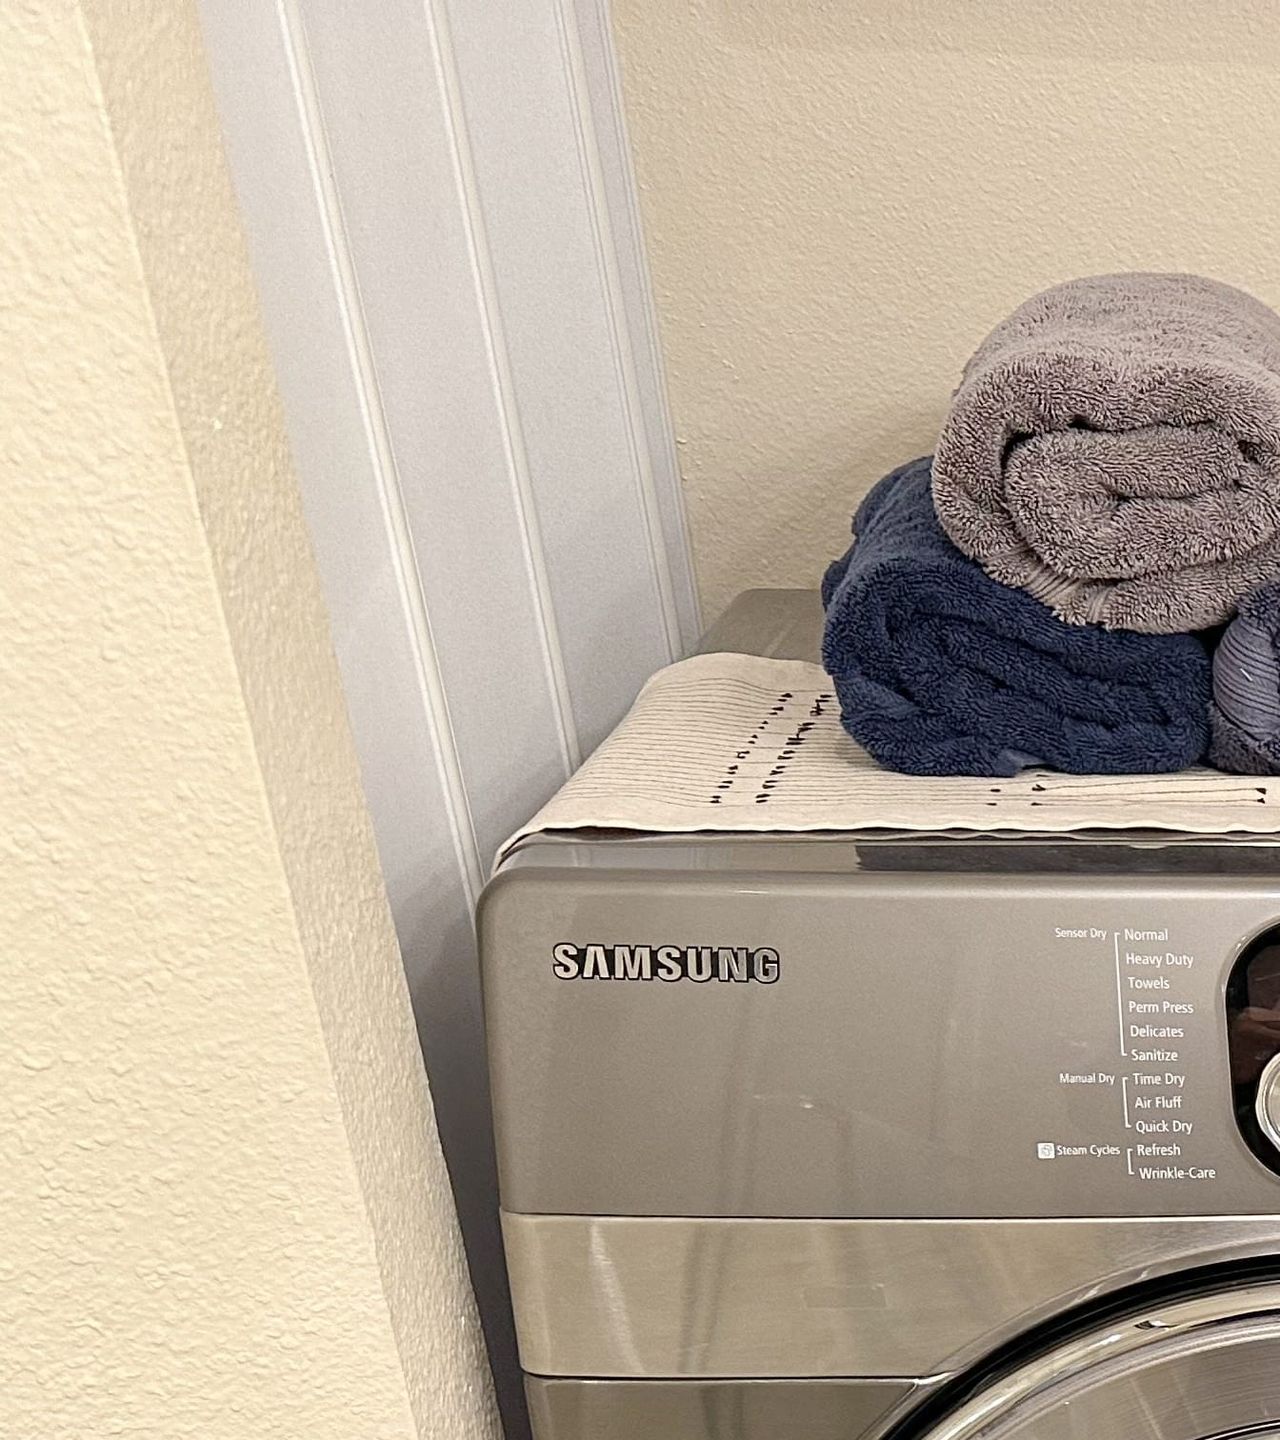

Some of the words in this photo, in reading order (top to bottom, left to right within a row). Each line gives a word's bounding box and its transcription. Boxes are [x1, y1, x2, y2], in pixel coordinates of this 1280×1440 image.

[1054, 927, 1087, 938] Sensor
[1089, 927, 1107, 941] Dry
[1124, 928, 1168, 942] Normal
[553, 942, 780, 984] SAMSUNG
[1126, 953, 1163, 968] Heavy
[1166, 953, 1194, 968] Duty
[1128, 976, 1170, 990] Towels
[1129, 1001, 1160, 1014] Perm
[1162, 1001, 1194, 1014] Press
[1130, 1025, 1184, 1038] Delicates
[1131, 1049, 1178, 1062] Sanitize
[1059, 1073, 1094, 1084] Manual
[1097, 1073, 1115, 1087] Dry
[1133, 1072, 1161, 1085] Time
[1164, 1072, 1185, 1088] Dry
[1134, 1096, 1152, 1109] Air
[1155, 1095, 1182, 1109] Fluff
[1136, 1120, 1169, 1133] Quick
[1172, 1120, 1193, 1136] Dry
[1057, 1144, 1087, 1156] Steam
[1089, 1144, 1121, 1158] Cycles
[1137, 1142, 1181, 1157] Refresh
[1139, 1165, 1216, 1180] Wrinkle-Care
